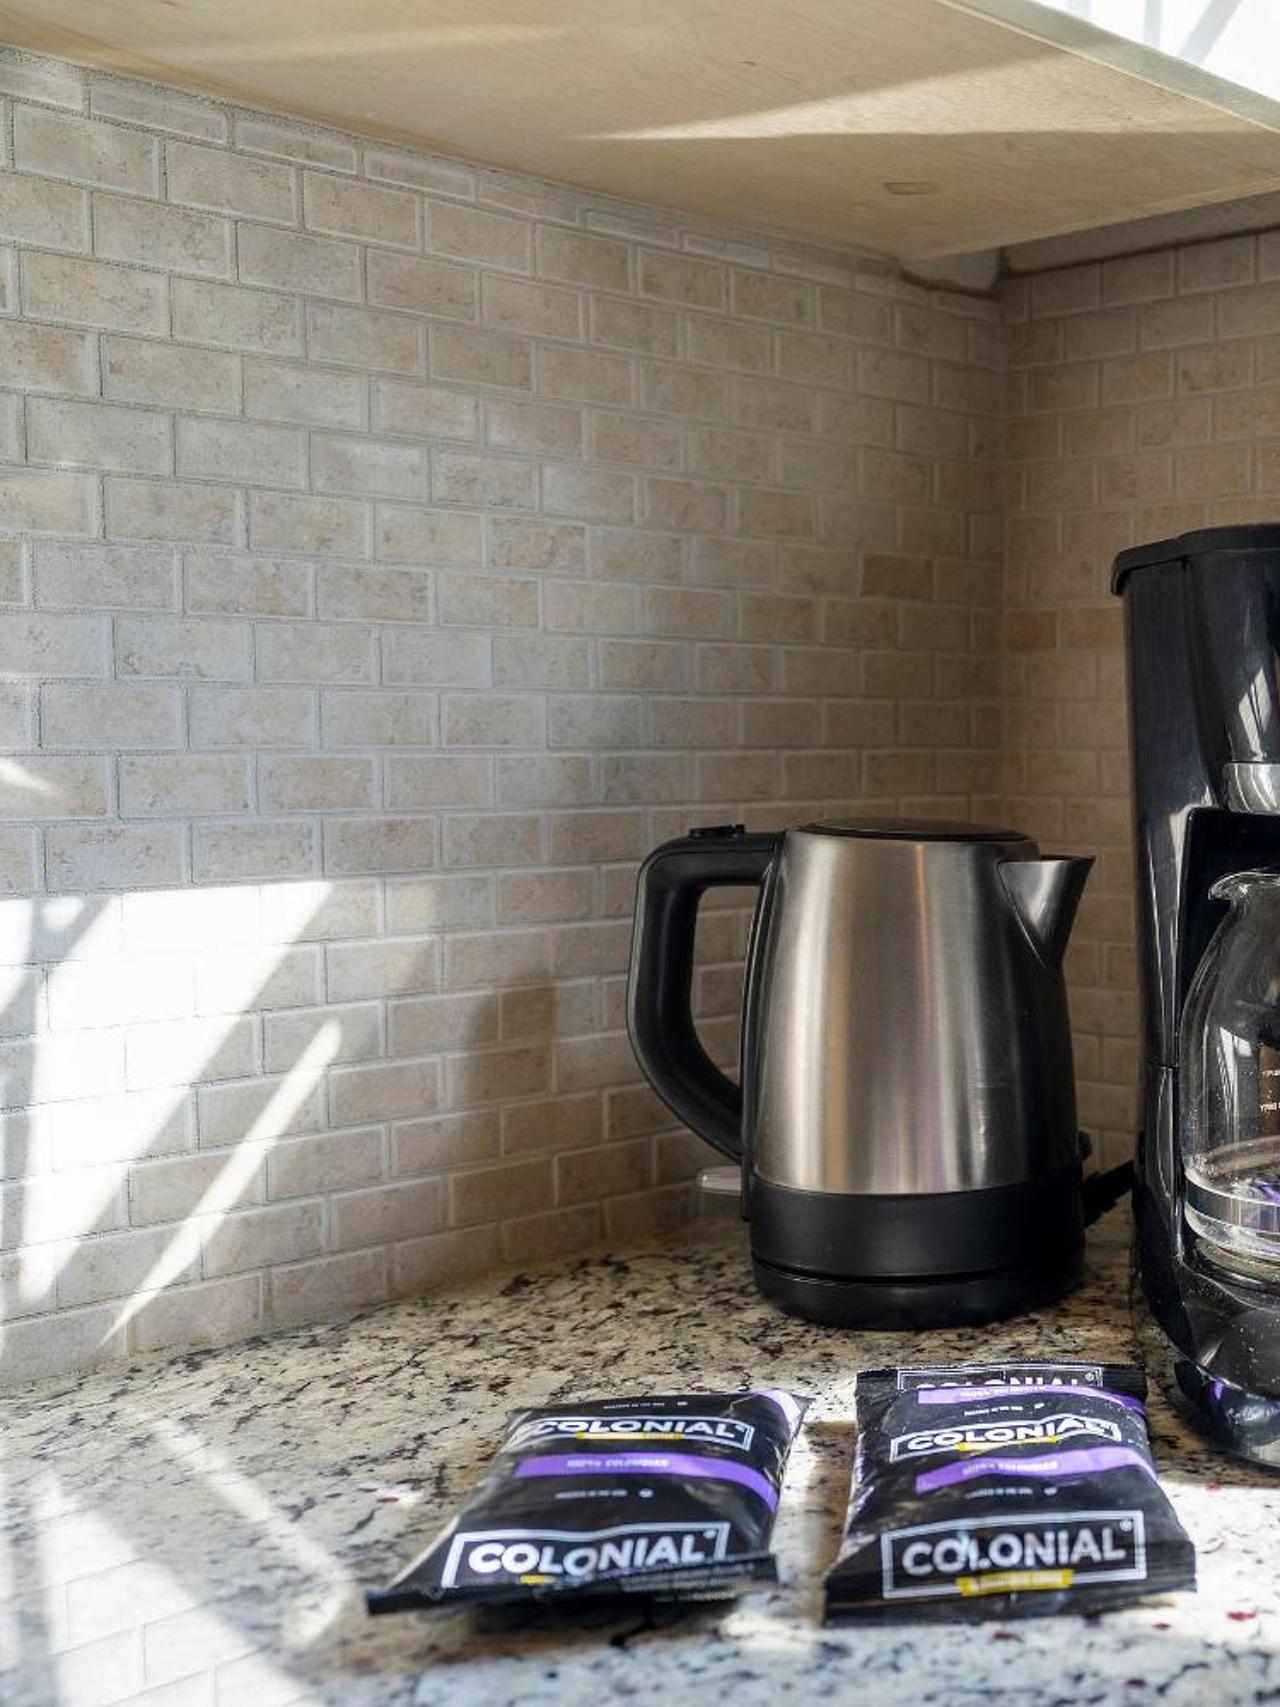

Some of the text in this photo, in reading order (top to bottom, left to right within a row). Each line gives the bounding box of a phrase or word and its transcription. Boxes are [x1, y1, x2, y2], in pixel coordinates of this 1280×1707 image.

[534, 1418, 737, 1438] COLONIAL
[468, 1533, 705, 1577] COLONIAL
[902, 1528, 1126, 1576] COLONIAL
